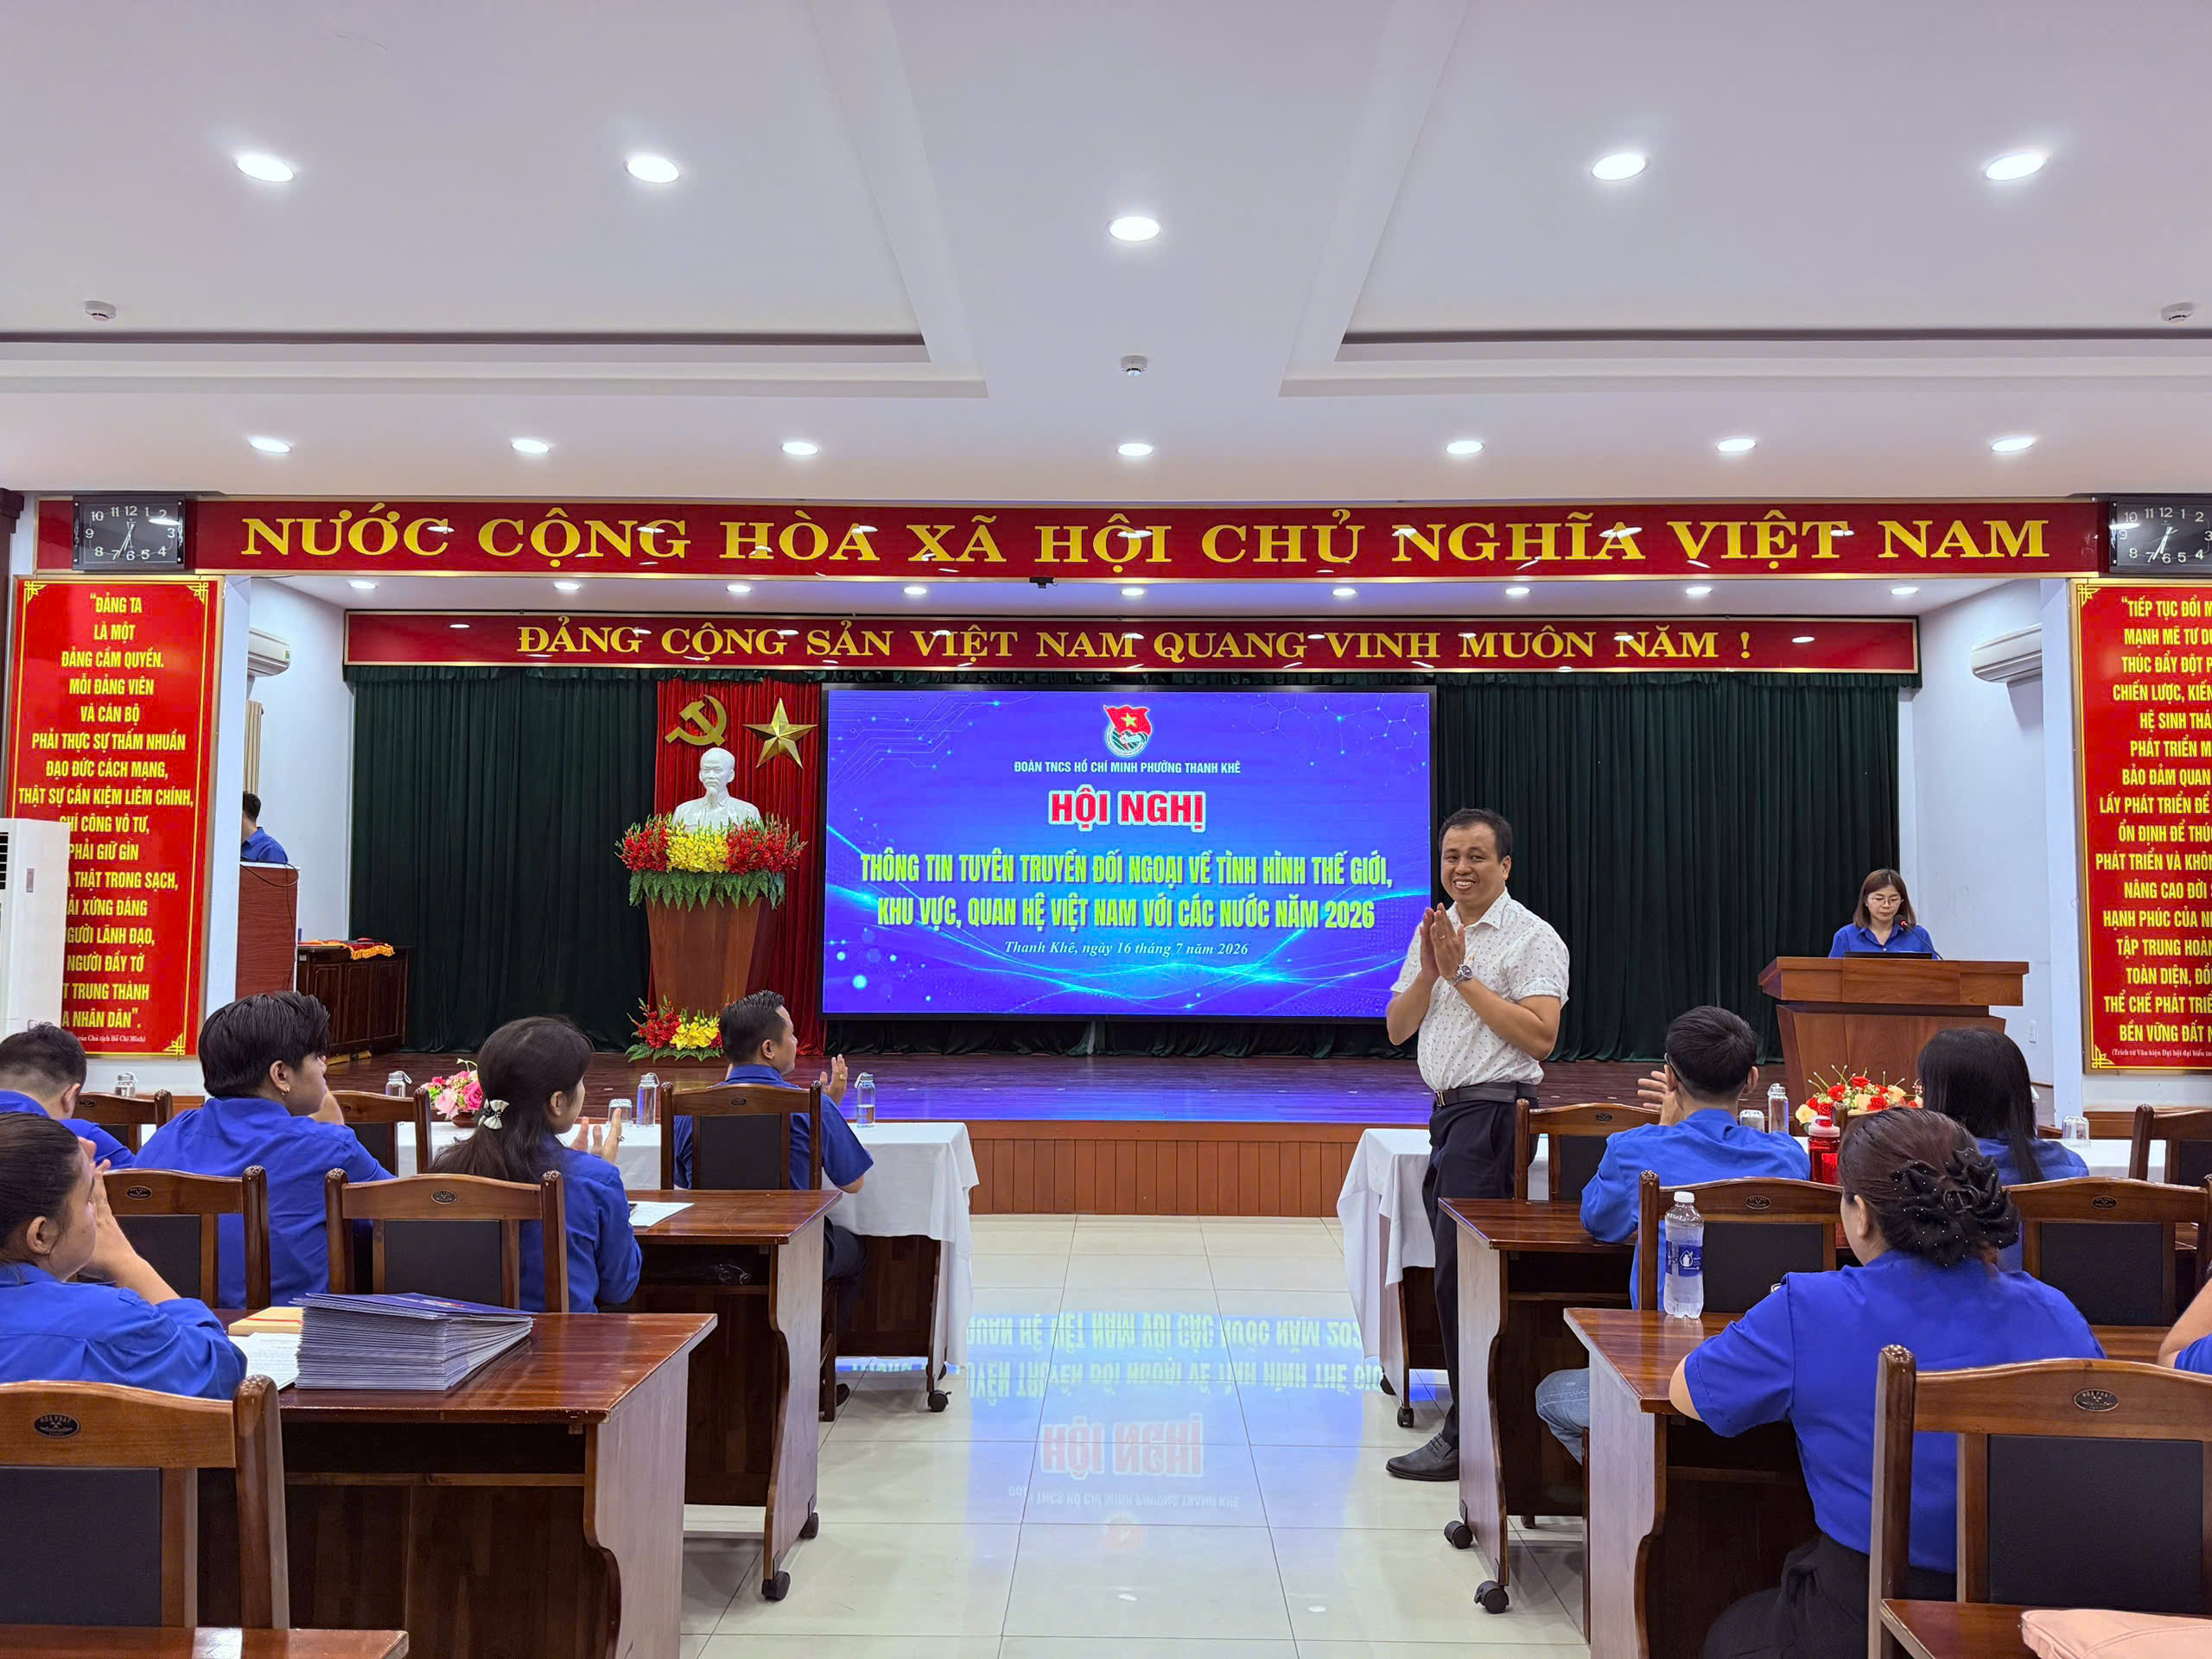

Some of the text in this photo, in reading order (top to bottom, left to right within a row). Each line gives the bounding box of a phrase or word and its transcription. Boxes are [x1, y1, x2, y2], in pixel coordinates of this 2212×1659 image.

[91, 512, 104, 521] 10
[111, 506, 119, 517] 11
[124, 505, 137, 516] 12
[145, 506, 149, 517] 1
[2145, 508, 2154, 518] 11
[2159, 507, 2173, 518] 12
[2181, 508, 2185, 518] 1
[2195, 512, 2204, 522] 2
[86, 528, 94, 538] 9
[167, 528, 175, 538] 3
[243, 504, 2050, 573] NƯỚC CỘNG HÒA XÃ HỘI CHỦ NGHĨA VIỆT NAM
[95, 547, 103, 556] 8
[111, 550, 119, 560] 7
[126, 550, 136, 561] 6
[141, 550, 150, 559] 5
[158, 546, 167, 556] 4
[2177, 552, 2186, 563] 5
[2195, 549, 2204, 560] 4
[129, 596, 143, 613] TA
[2155, 600, 2178, 621] TỤC
[2180, 594, 2202, 618] ĐỔI
[93, 620, 137, 644] LÀ MỘT
[518, 618, 1750, 664] ĐẢNG CỘNG SẢN VIỆT NAM QUANG VINH MUÔN NĂM !
[2124, 628, 2160, 649] MẠNH
[2162, 625, 2182, 645] MẼ
[2183, 626, 2200, 645] TƯ
[2120, 652, 2152, 673] THÚC
[2154, 649, 2178, 673] ĐẨY
[2180, 652, 2203, 677] ĐỘT
[68, 672, 155, 696] MỖI ĐẢNG VIÊN
[80, 702, 140, 727] VÀ CÁN BỘ
[2139, 709, 2187, 733] HỆ SINH
[2130, 737, 2161, 758] PHÁT
[2163, 734, 2198, 758] TRIỂN
[46, 757, 168, 782] ĐẠO ĐỨC CÁCH MẠNG,
[1014, 758, 1241, 773] ĐOÀN TNCS HỒ CHÍ MINH PHƯỜNG THANH KHÊ
[2121, 763, 2211, 788] BẢO ĐẢM QUAN
[1050, 785, 1205, 832] HỘI NGHỊ
[80, 812, 149, 835] CÔNG VÔ TƯ,
[861, 847, 1392, 887] THÔNG TIN TUYÊN TRUYỀN ĐỐI NGOẠI VỀ TÌNH HÌNH THẾ GIỚI,
[74, 868, 103, 892] THẬT
[104, 871, 143, 889] TRONG
[144, 871, 179, 893] SẠCH,
[2124, 878, 2208, 899] NÂNG CAO ĐỜI
[878, 893, 1375, 931] KHU VỰC, QUAN HỆ VIỆT NAM VỚI CÁC NƯỚC NĂM 2026
[2102, 910, 2137, 931] HẠNH
[2139, 906, 2171, 928] PHÚC
[2173, 905, 2199, 928] CỦA
[67, 923, 156, 948] GƯỜI LÃNH ĐẠO,
[1005, 941, 1249, 957] Thanh Khê, ngày 16 tháng 7 năm 2026
[2116, 935, 2182, 959] TẬP TRUNG
[67, 951, 103, 972] NGƯỜI
[130, 952, 145, 973] TỚ
[2126, 963, 2192, 988] TOÀN DIỆN,
[72, 982, 110, 1000] TRUNG
[111, 980, 150, 1001] THÀNH
[2119, 1019, 2144, 1042] BỀN
[2145, 1021, 2179, 1042] VỮNG
[2181, 1020, 2204, 1042] ĐẤT
